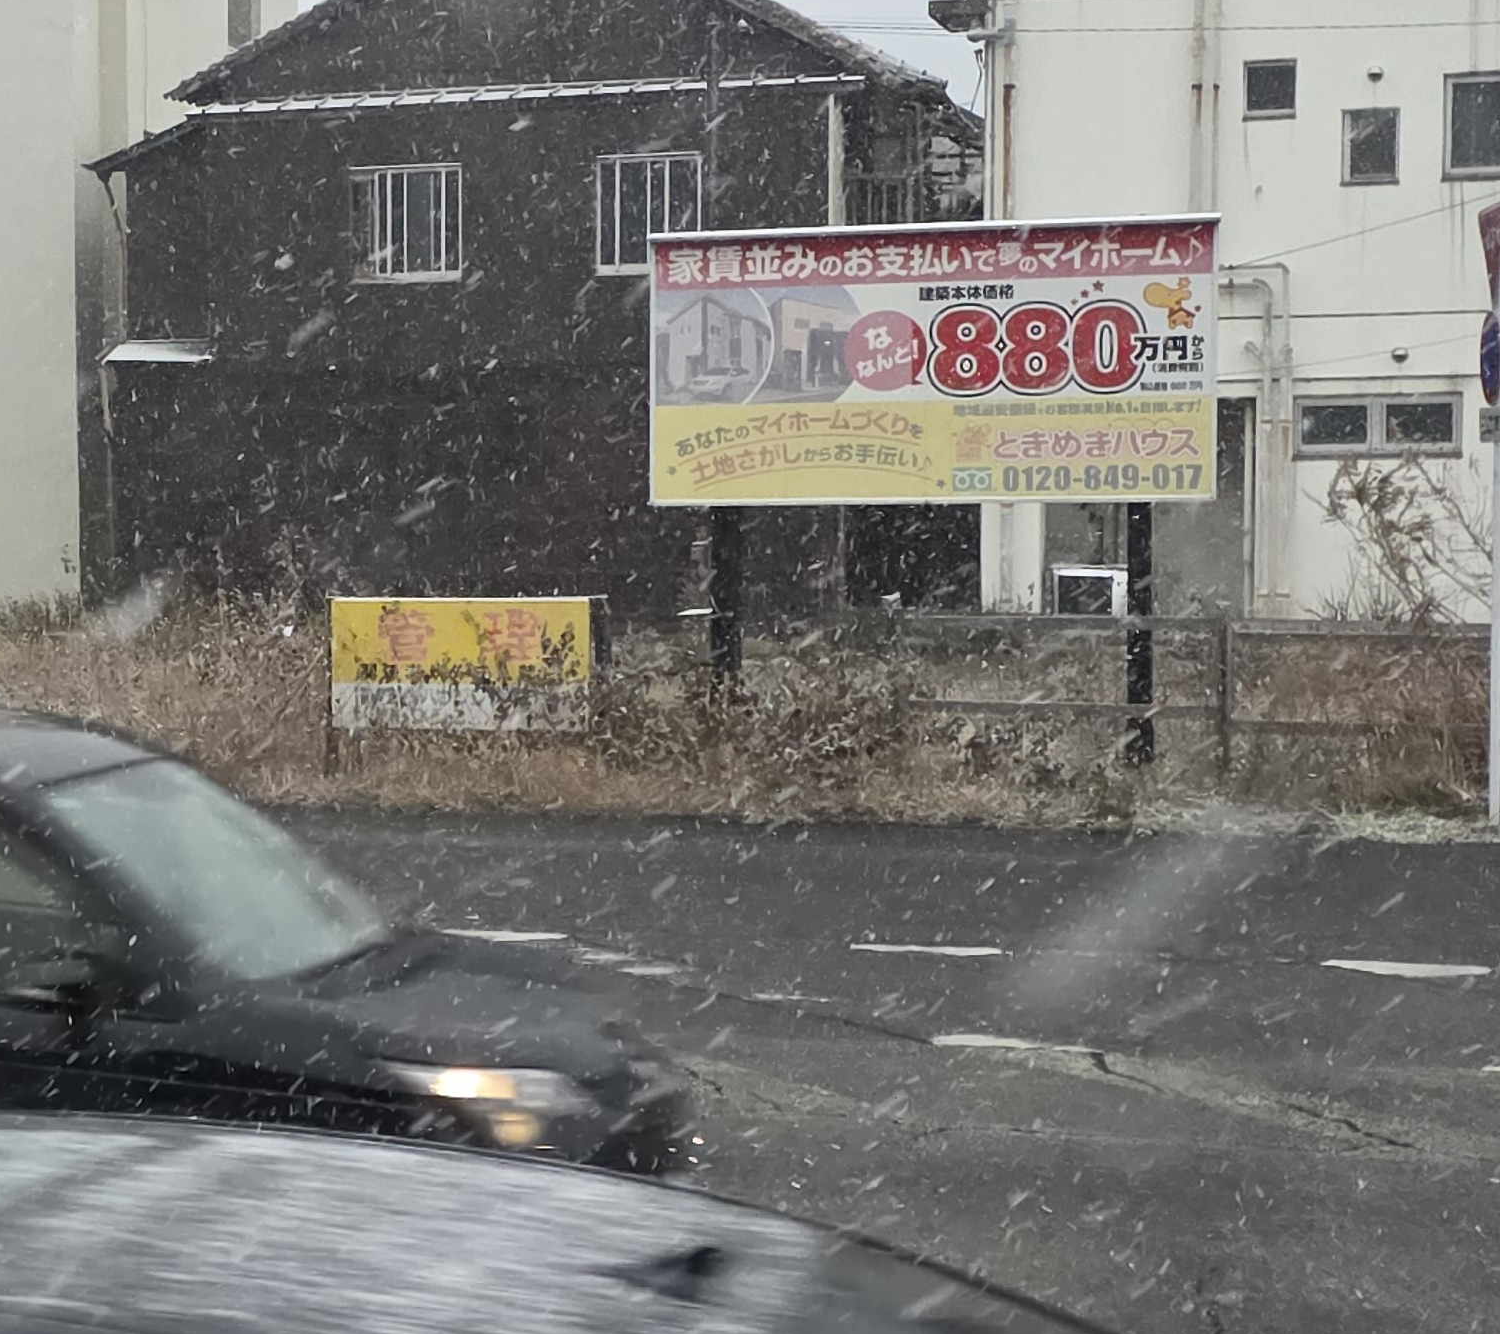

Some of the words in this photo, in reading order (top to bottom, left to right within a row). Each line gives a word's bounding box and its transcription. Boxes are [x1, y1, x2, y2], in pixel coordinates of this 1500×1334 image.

[918, 284, 1014, 302] 建築本体価格
[674, 409, 924, 457] あなたのマイホームづくりを
[993, 428, 1200, 459] ときめきハウス
[1002, 463, 1203, 492] 0120-849-017
